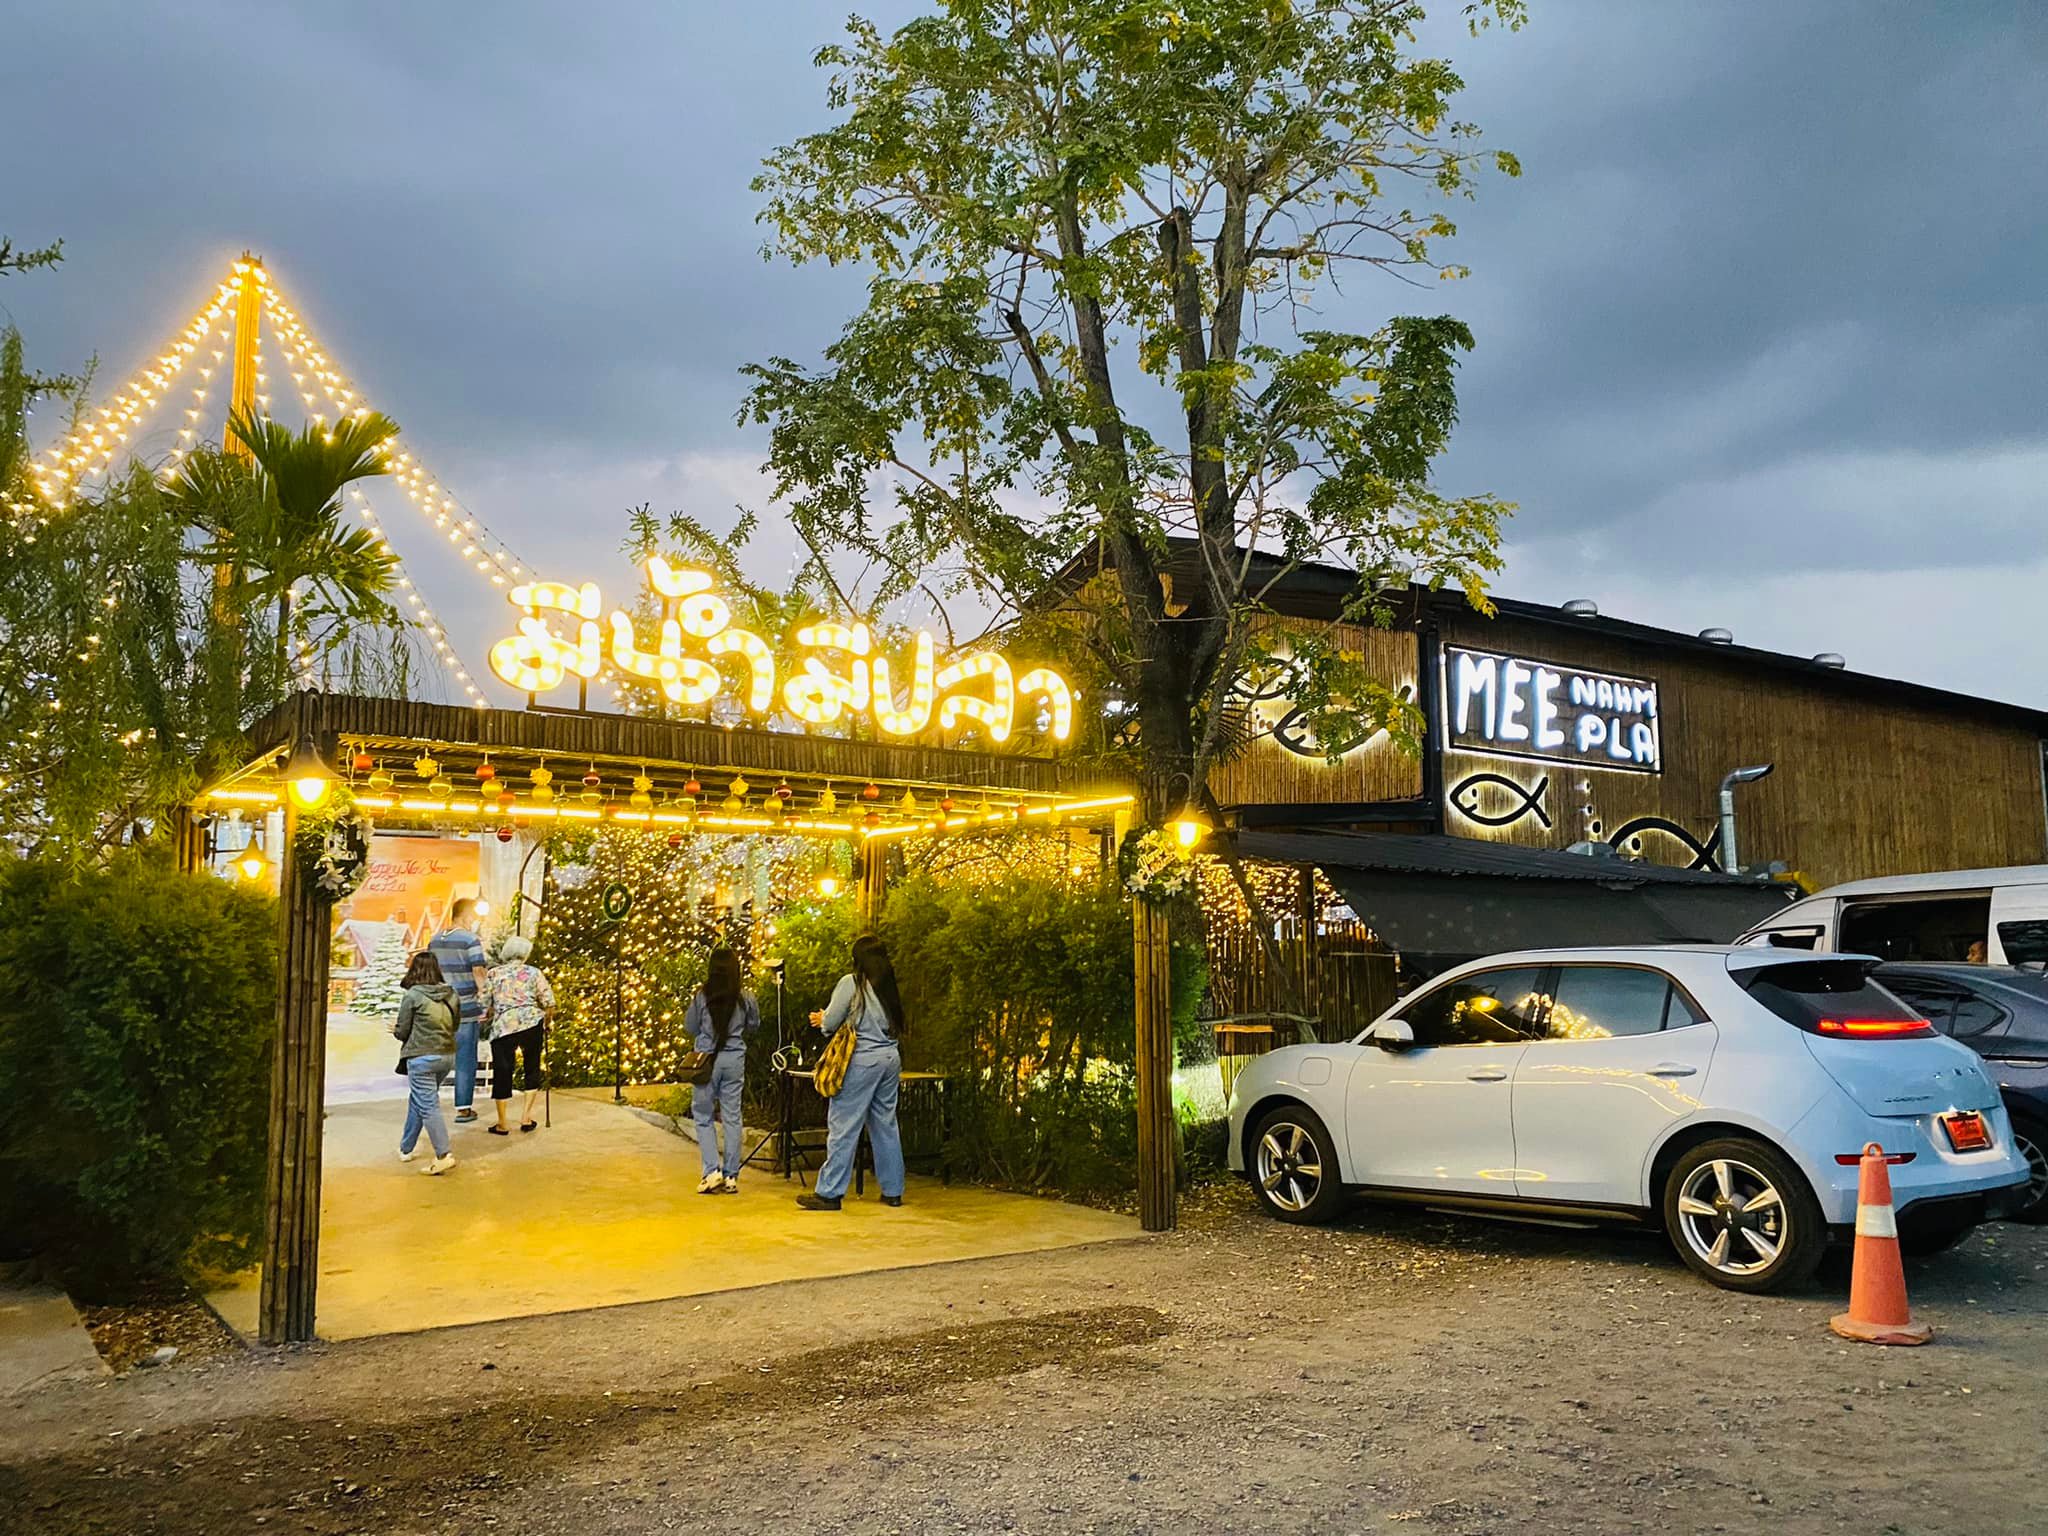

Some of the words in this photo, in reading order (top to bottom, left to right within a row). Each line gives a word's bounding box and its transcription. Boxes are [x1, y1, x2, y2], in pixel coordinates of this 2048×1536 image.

[490, 556, 1072, 741] มีน้ำมีปลา
[1456, 653, 1564, 748] MEE
[1571, 675, 1656, 717] NAHM
[1576, 713, 1655, 763] PLA
